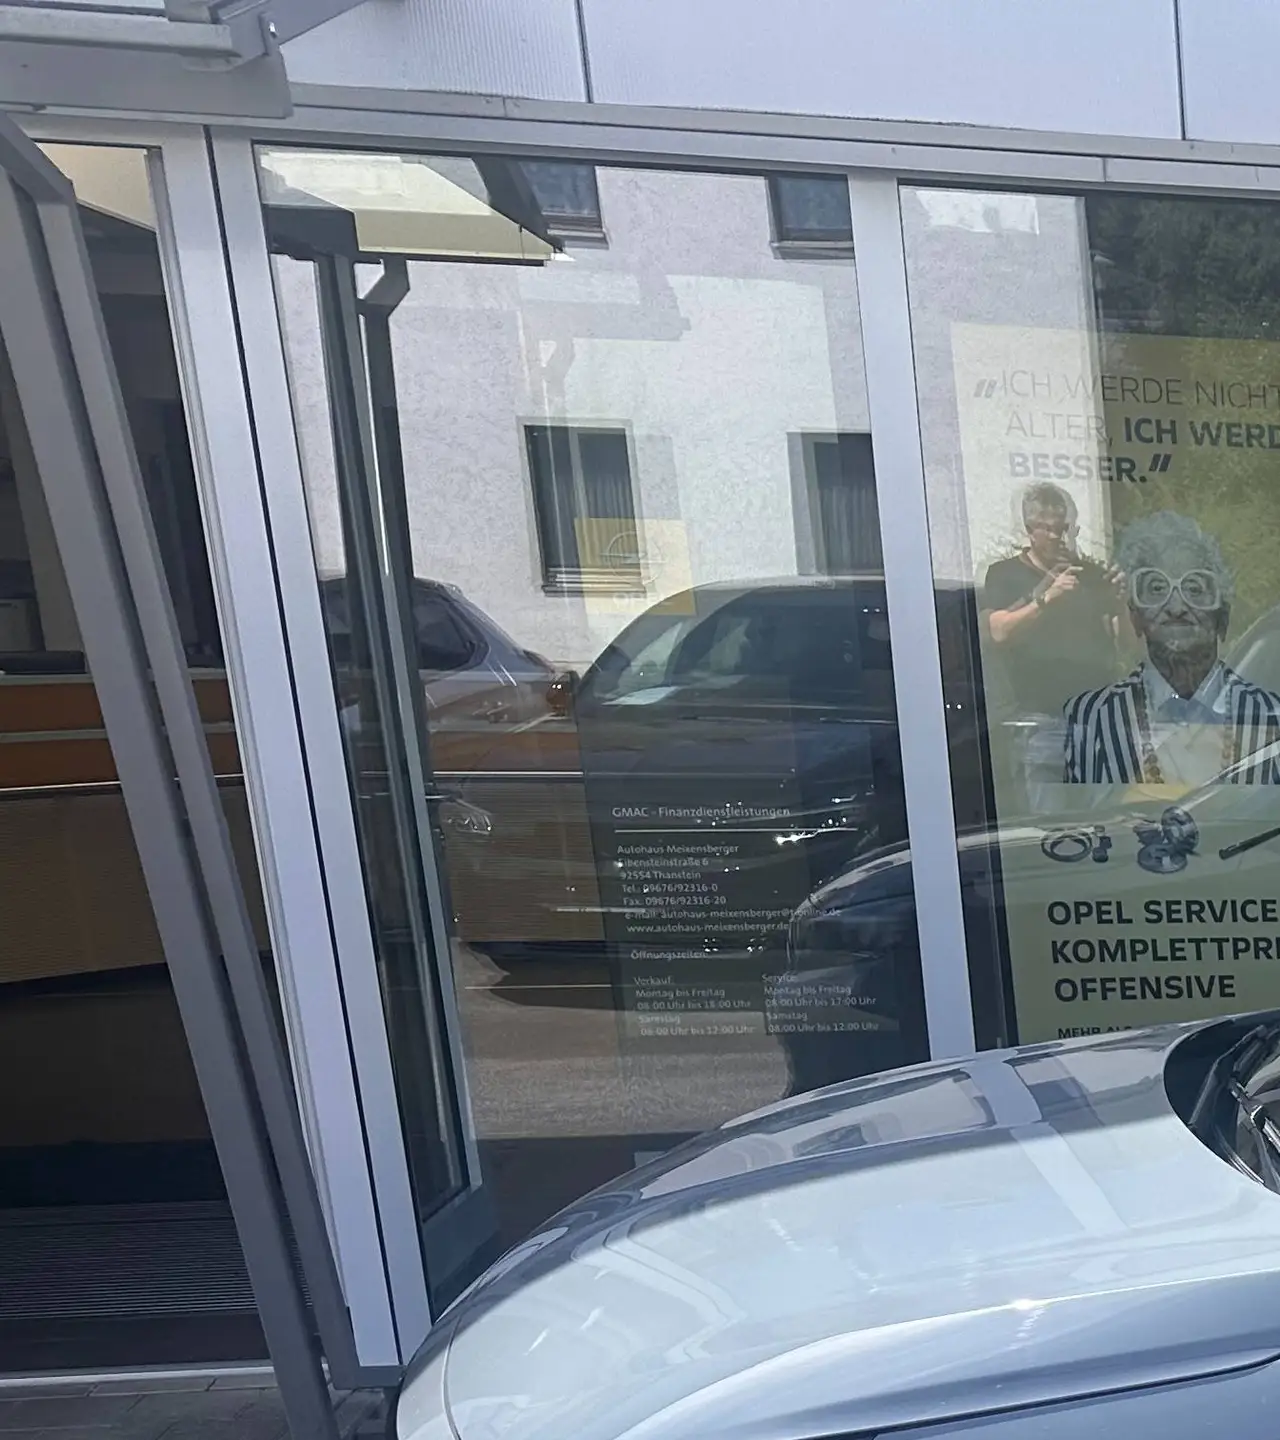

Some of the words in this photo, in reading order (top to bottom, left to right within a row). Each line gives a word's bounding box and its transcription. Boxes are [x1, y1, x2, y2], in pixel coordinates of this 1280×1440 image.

[1064, 373, 1183, 406] WERDE
[1005, 404, 1113, 448] ÄLTER,
[1124, 416, 1178, 445] ICH
[612, 807, 649, 818] GMAC
[658, 806, 791, 819] Finanzdienstleistungen
[617, 845, 664, 854] Autohaus
[666, 844, 739, 855] Meixensberger
[653, 870, 701, 880] Thanstein
[1047, 900, 1133, 925] OPEL
[1144, 899, 1279, 924] SERVICE
[1054, 975, 1236, 1002] OFFENSIVE
